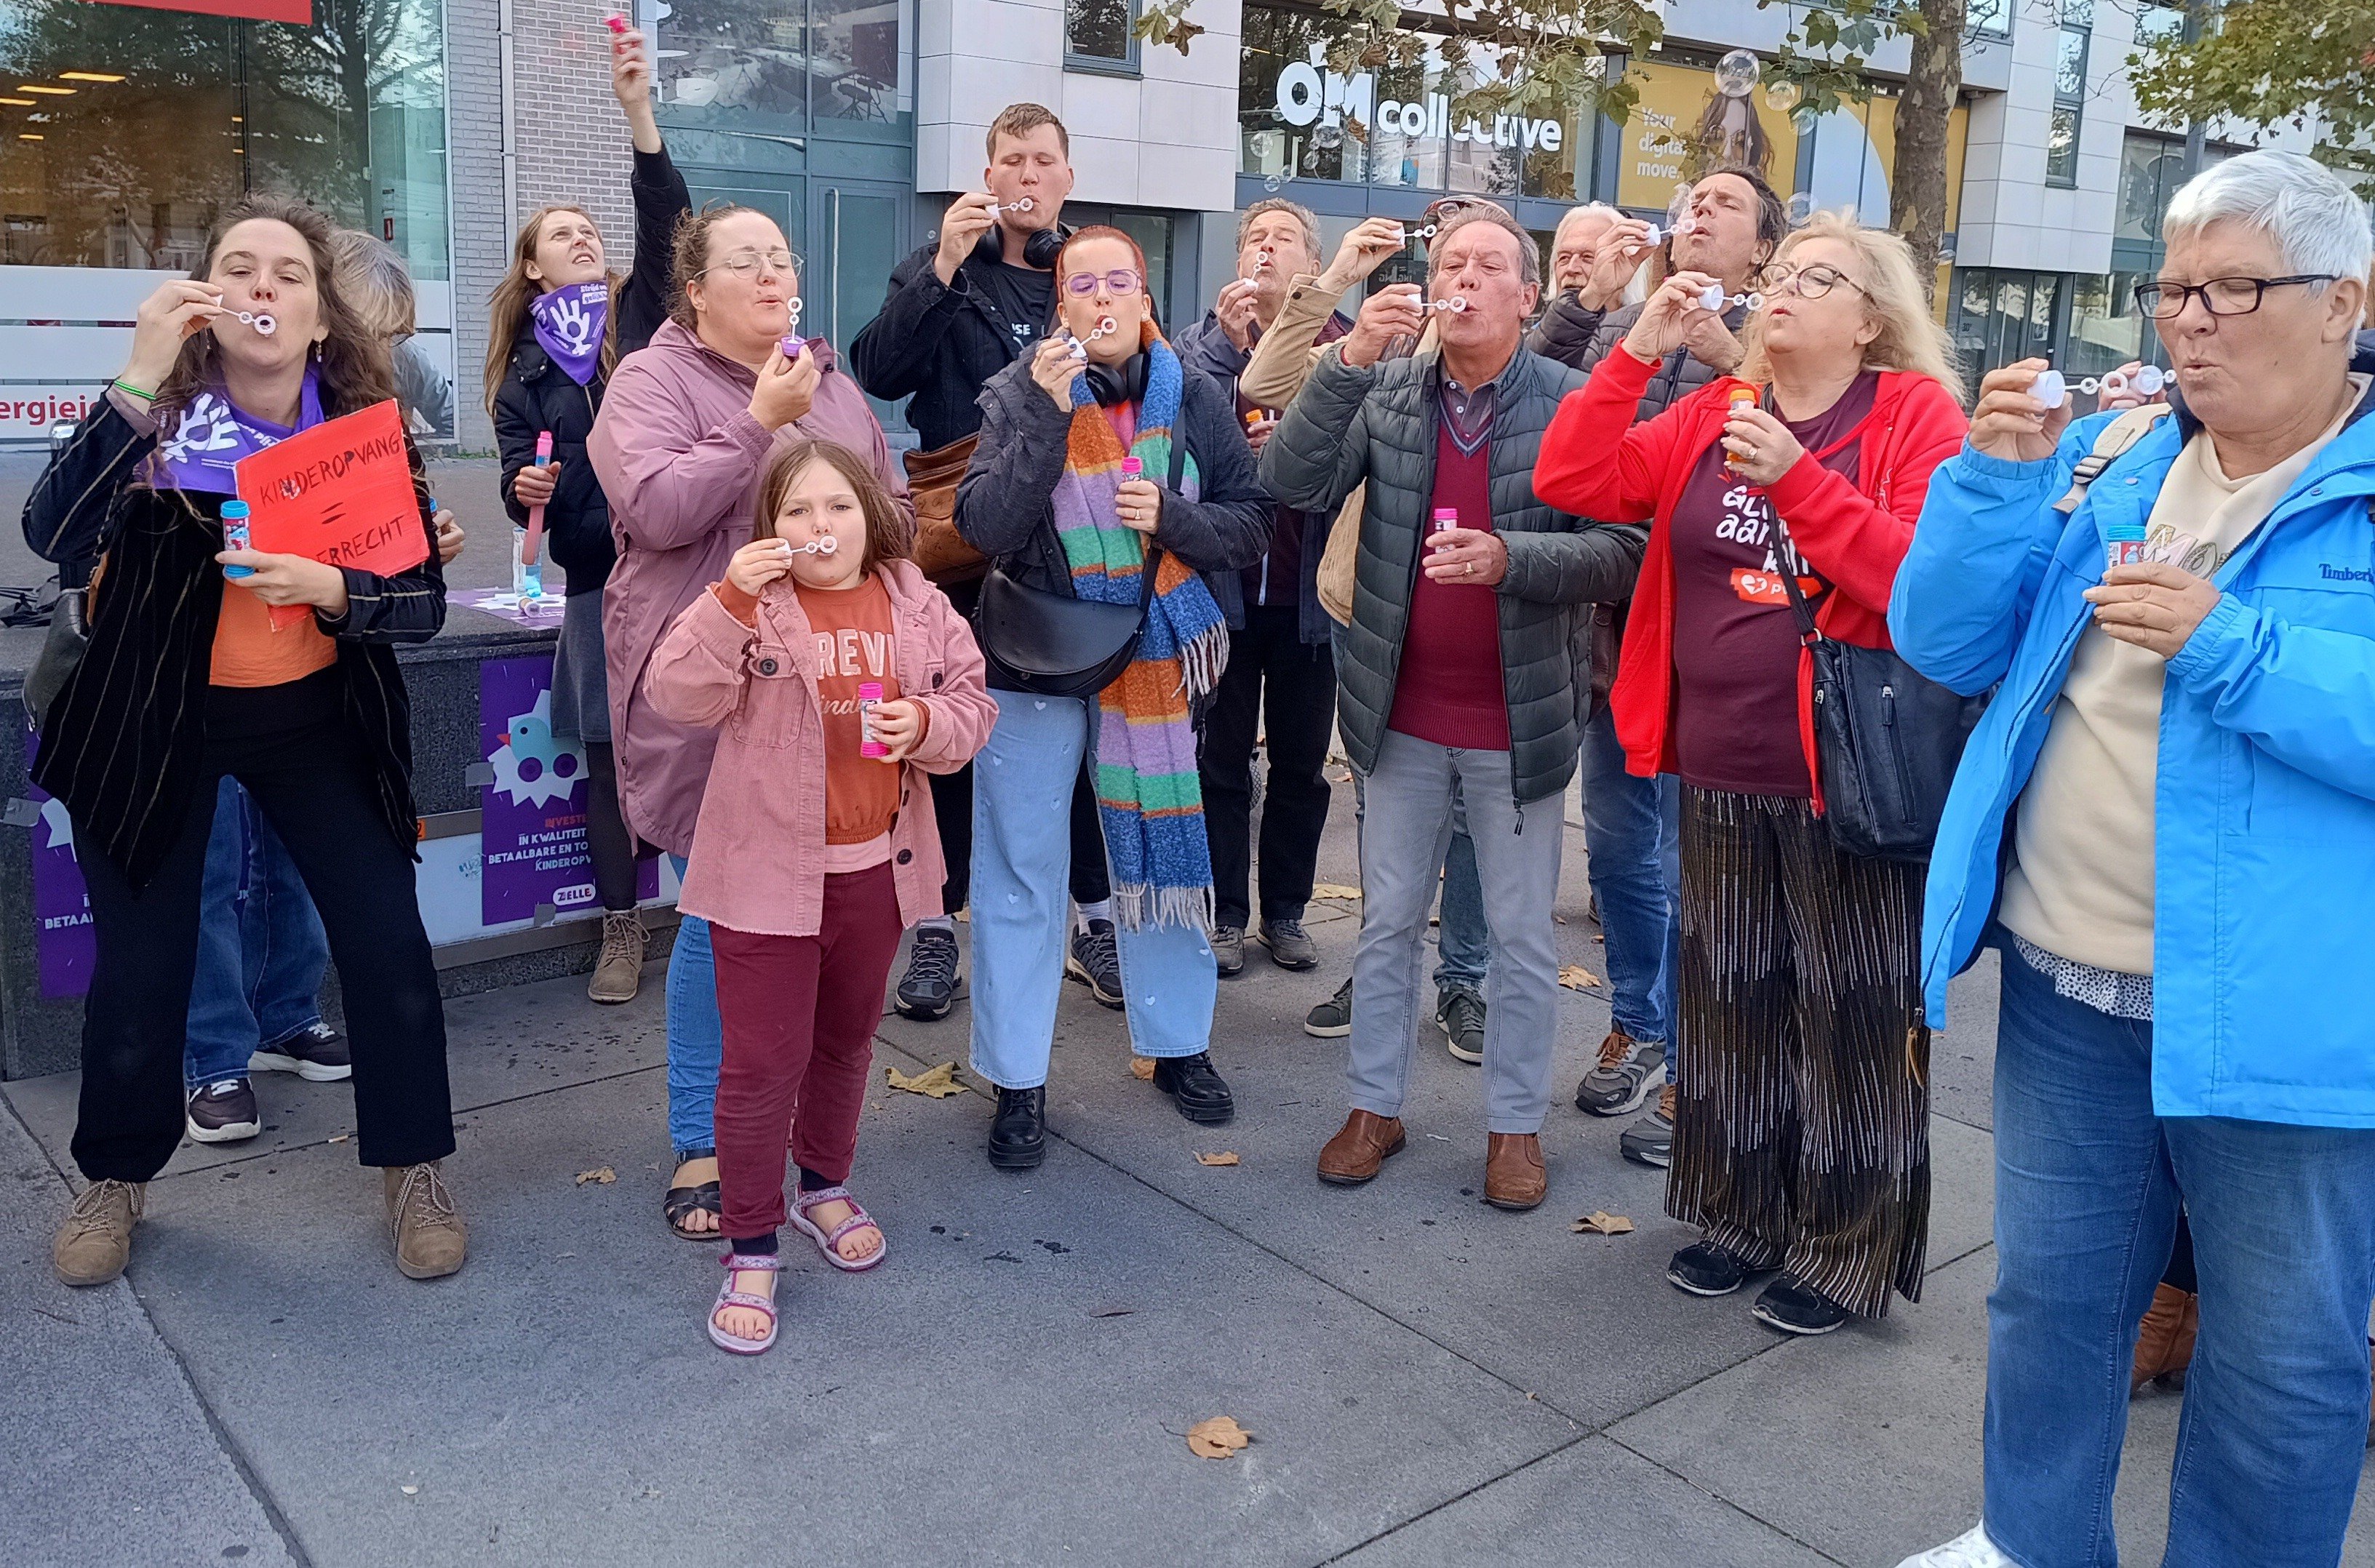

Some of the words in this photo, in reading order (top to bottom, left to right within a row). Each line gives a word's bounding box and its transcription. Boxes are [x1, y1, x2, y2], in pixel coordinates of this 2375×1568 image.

[1641, 106, 1676, 129] Your
[1637, 161, 1680, 179] move.
[260, 431, 400, 508] KINDEROPVANG
[316, 515, 404, 565] ERRECHT
[531, 828, 586, 844] KWALITEIT
[488, 845, 556, 865] BETAALBARE
[559, 843, 572, 855] EN
[574, 841, 588, 852] TO
[535, 854, 591, 871] KINDEROPV
